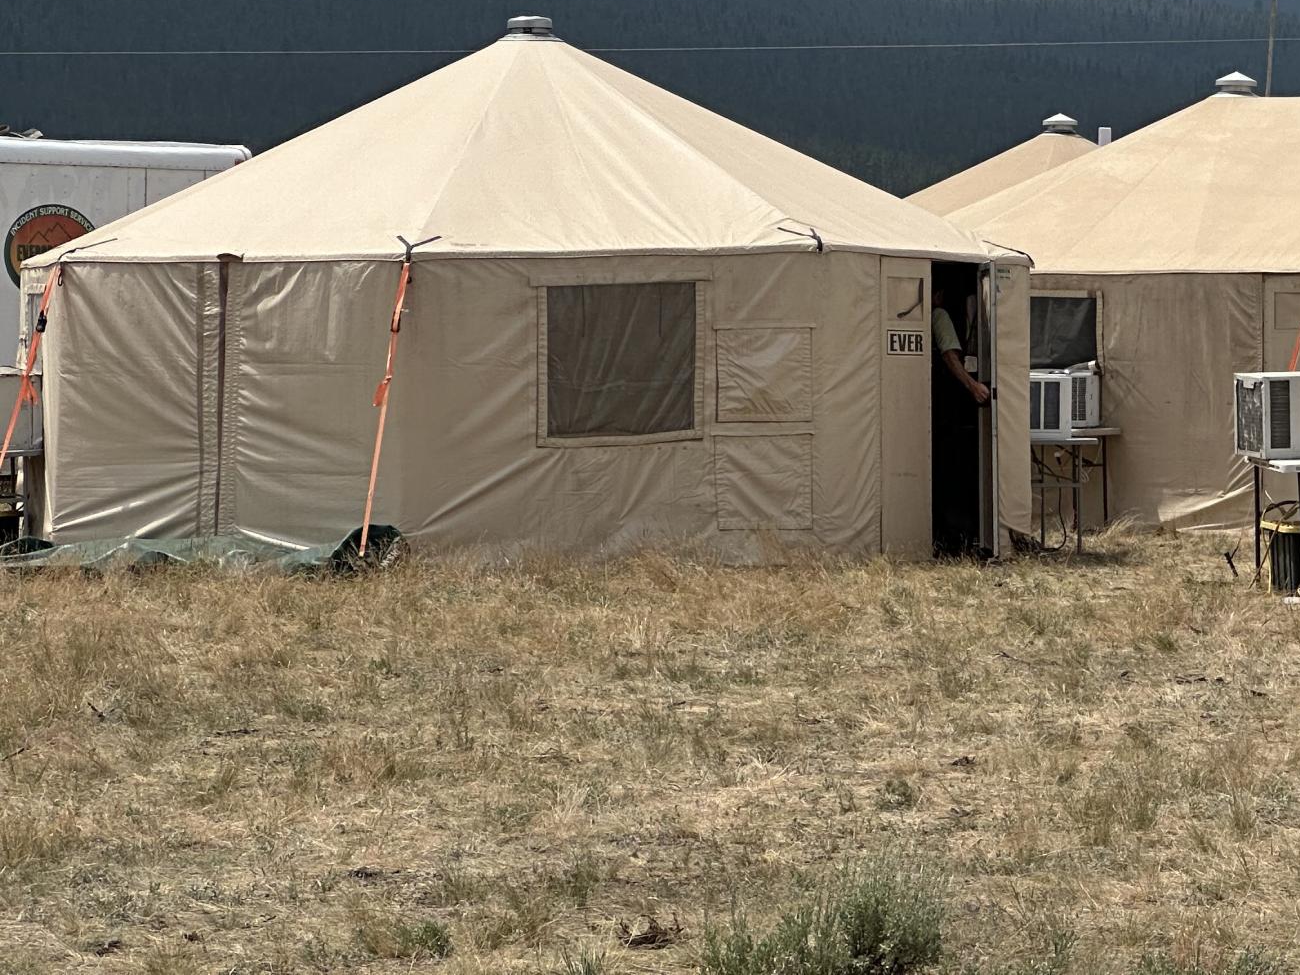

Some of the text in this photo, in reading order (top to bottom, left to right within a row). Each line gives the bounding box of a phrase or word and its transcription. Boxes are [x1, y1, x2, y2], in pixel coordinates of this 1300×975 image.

[10, 210, 38, 236] INCIDENT
[39, 206, 69, 216] SUPPORT
[890, 333, 923, 352] EVER
